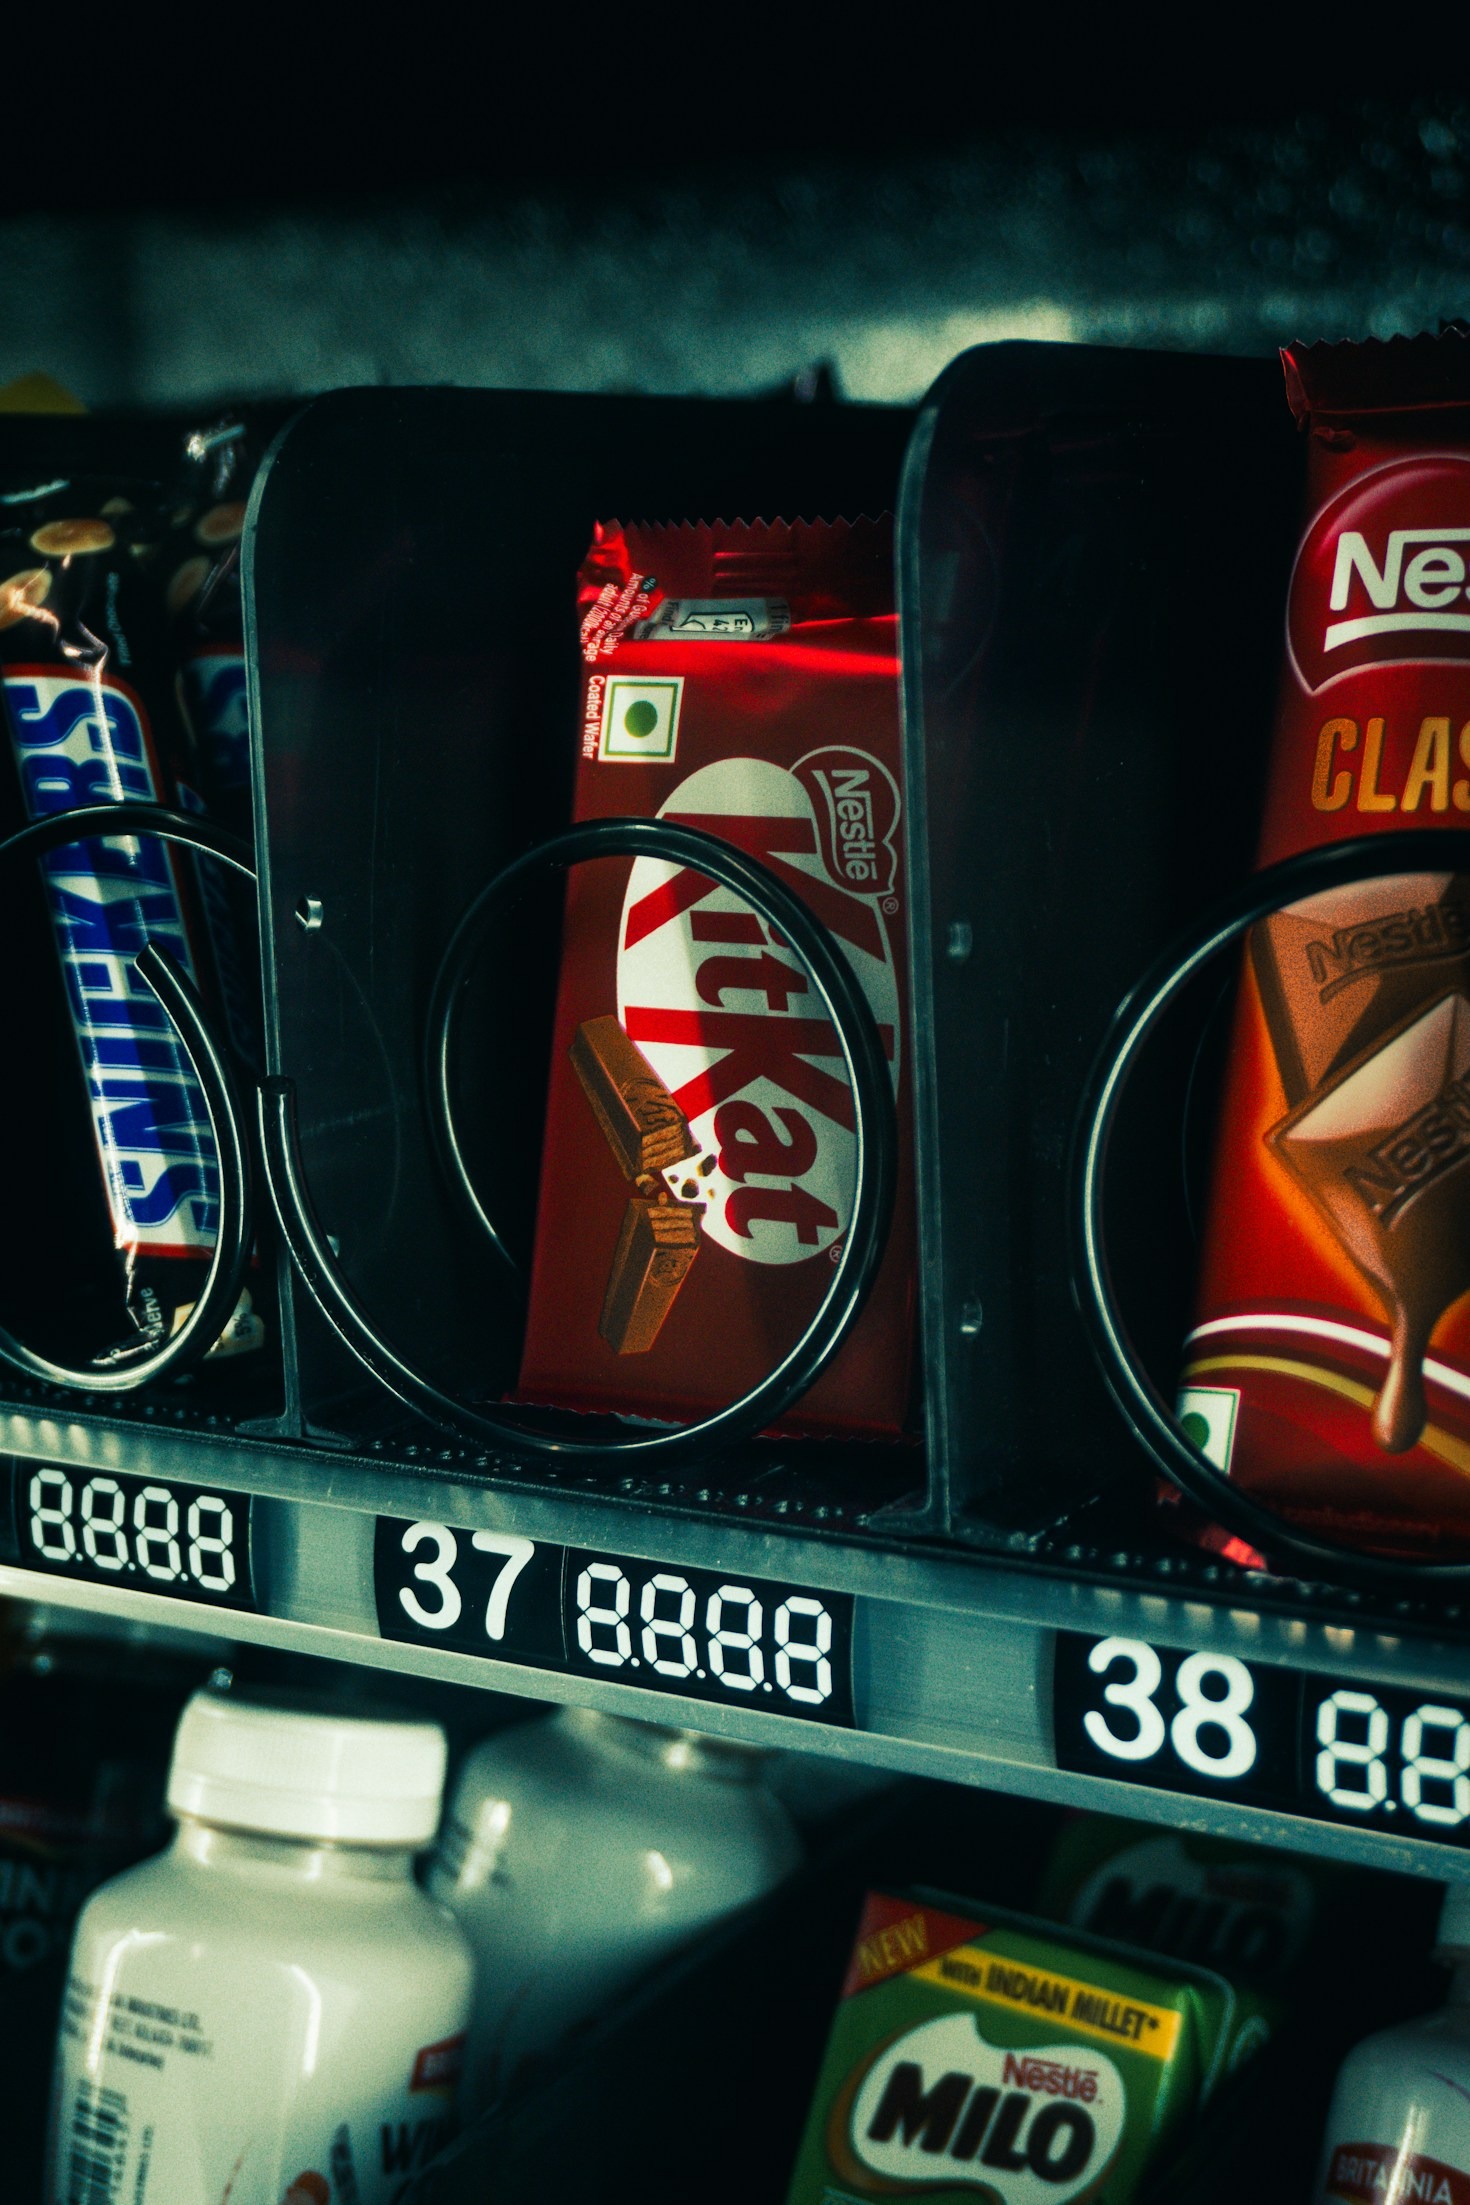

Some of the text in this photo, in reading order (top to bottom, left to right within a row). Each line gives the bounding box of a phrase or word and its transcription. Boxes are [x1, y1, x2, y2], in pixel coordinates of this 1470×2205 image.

[597, 583, 619, 608] adult
[613, 572, 645, 614] Amounts
[637, 593, 651, 604] of
[1329, 528, 1470, 612] Ne
[600, 631, 624, 655] Daily
[582, 674, 606, 760] Coated Wafer
[5, 684, 220, 1234] SNICKERS
[623, 811, 895, 1248] KitKat
[399, 1520, 536, 1641] 37
[1083, 1635, 1258, 1780] 38
[857, 1911, 929, 1978] NEW
[986, 1962, 1071, 2014] INDIAN
[867, 2060, 1097, 2184] MILO
